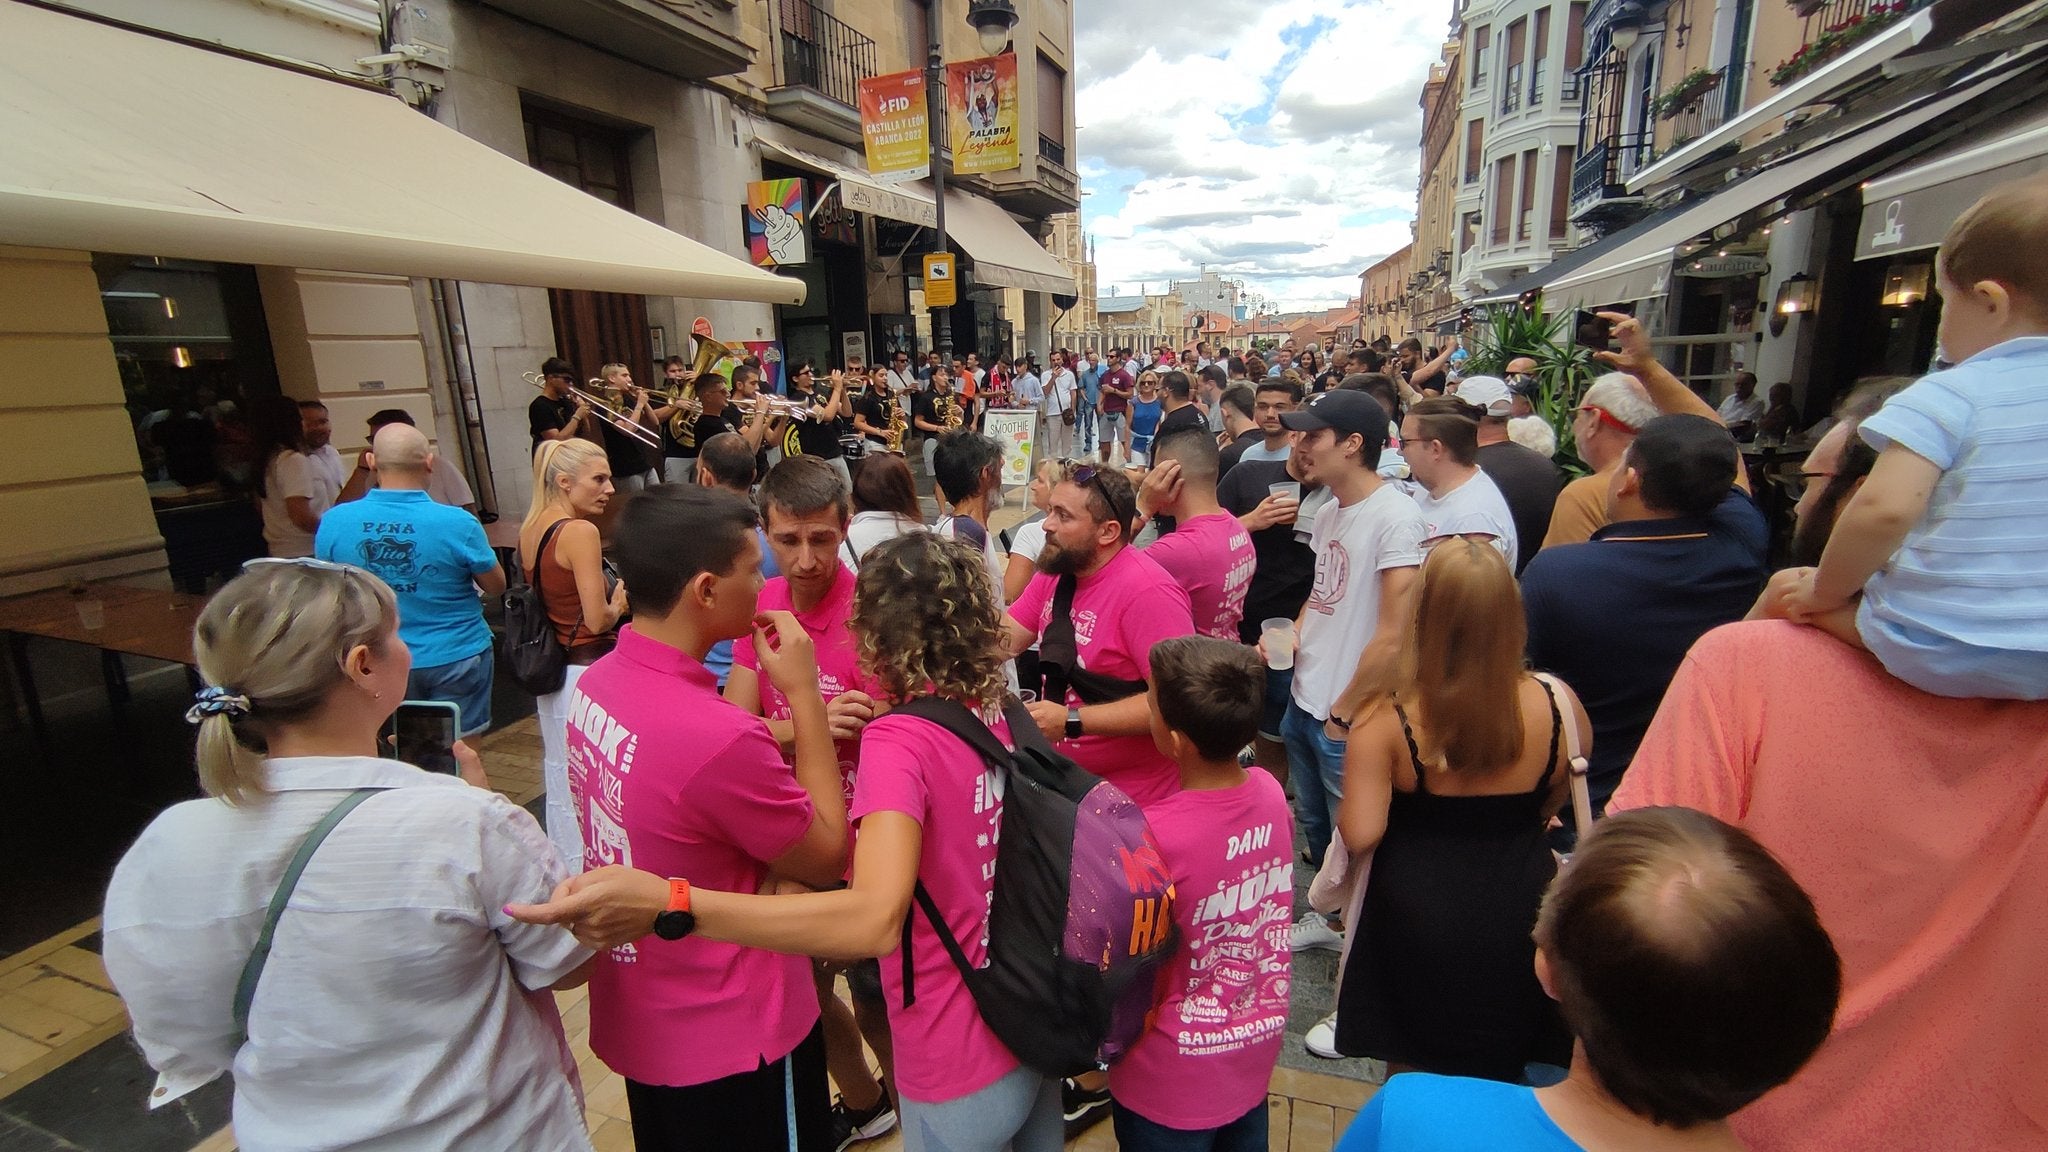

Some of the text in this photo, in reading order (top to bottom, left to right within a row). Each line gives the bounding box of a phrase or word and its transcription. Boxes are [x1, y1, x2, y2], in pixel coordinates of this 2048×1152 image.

[888, 97, 909, 113] FID
[866, 114, 925, 135] CASTILLA Y LEÓN
[969, 126, 1011, 139] PALABRA
[875, 129, 922, 146] ABANCA 2022
[958, 133, 1016, 156] Leyenda
[371, 541, 407, 561] Tito
[1226, 823, 1273, 861] DANI
[1197, 995, 1219, 1007] Pub
